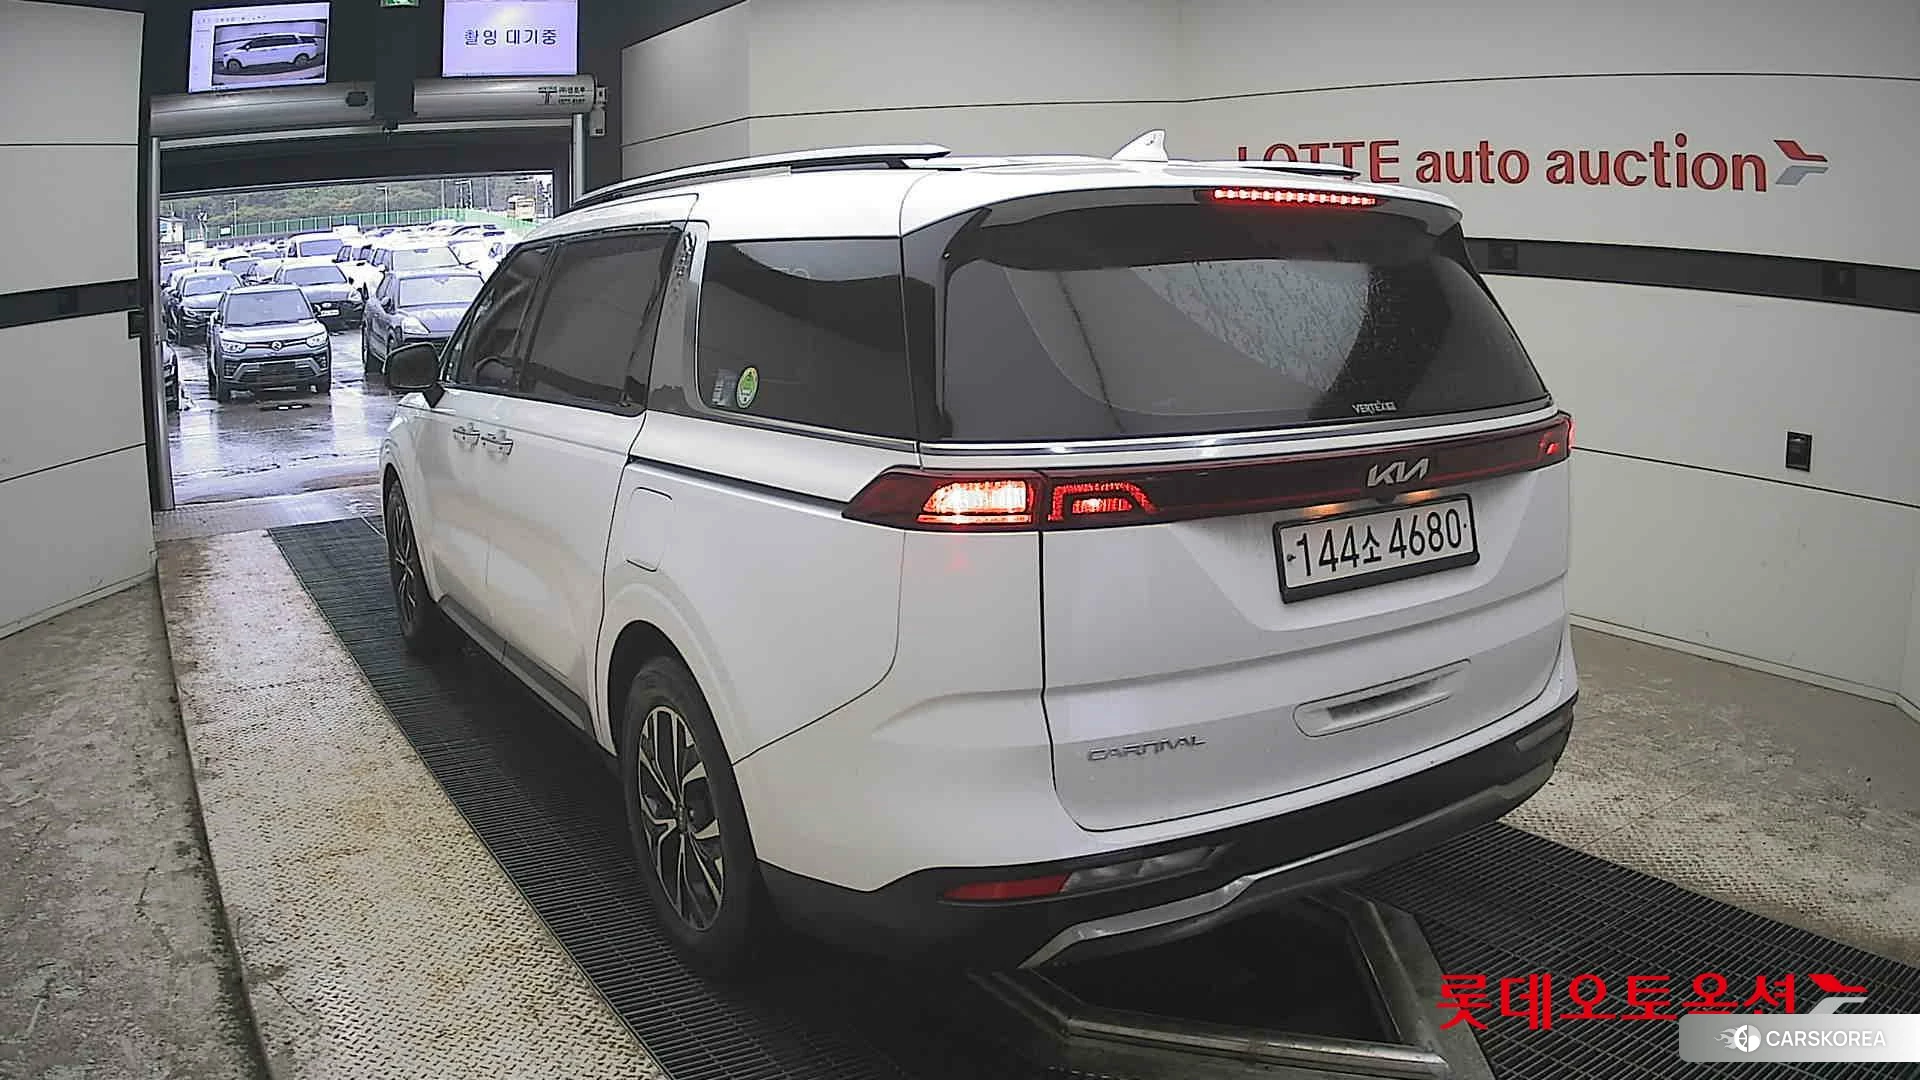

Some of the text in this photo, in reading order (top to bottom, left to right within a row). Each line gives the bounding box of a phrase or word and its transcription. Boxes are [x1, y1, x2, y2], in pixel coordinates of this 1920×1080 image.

[506, 29, 557, 46] 대기중
[1416, 140, 1529, 185] auto
[1546, 133, 1767, 193] auction
